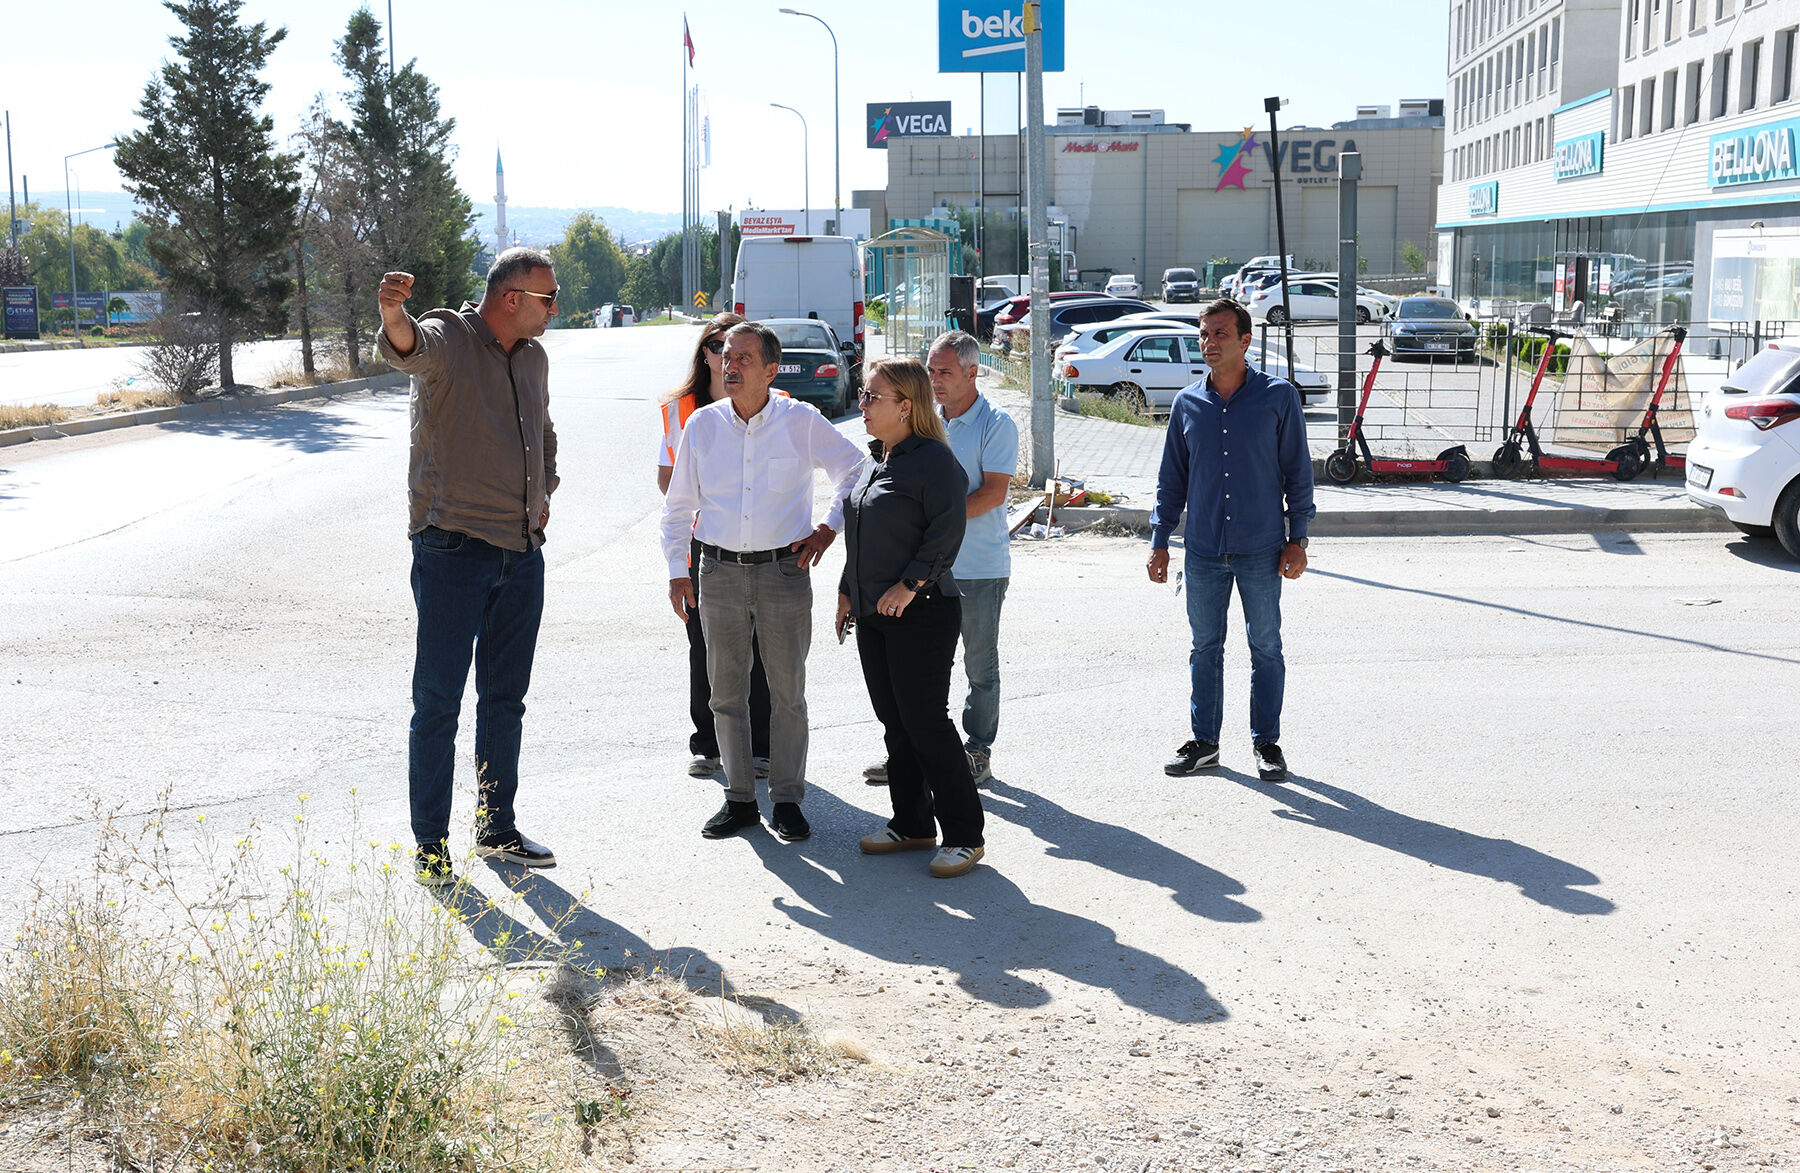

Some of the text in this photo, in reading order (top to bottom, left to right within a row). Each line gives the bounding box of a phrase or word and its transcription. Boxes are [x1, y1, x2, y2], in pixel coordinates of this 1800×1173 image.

[962, 9, 1042, 38] bek
[896, 115, 948, 133] VEGA
[1062, 141, 1139, 152] Media Markt
[1555, 138, 1594, 172] BELLONA
[1712, 128, 1795, 177] BELLONA
[1469, 185, 1492, 205] BELLONA
[743, 226, 793, 234] MediaMarkt'tan
[744, 216, 782, 226] BEYAZ EŞYA
